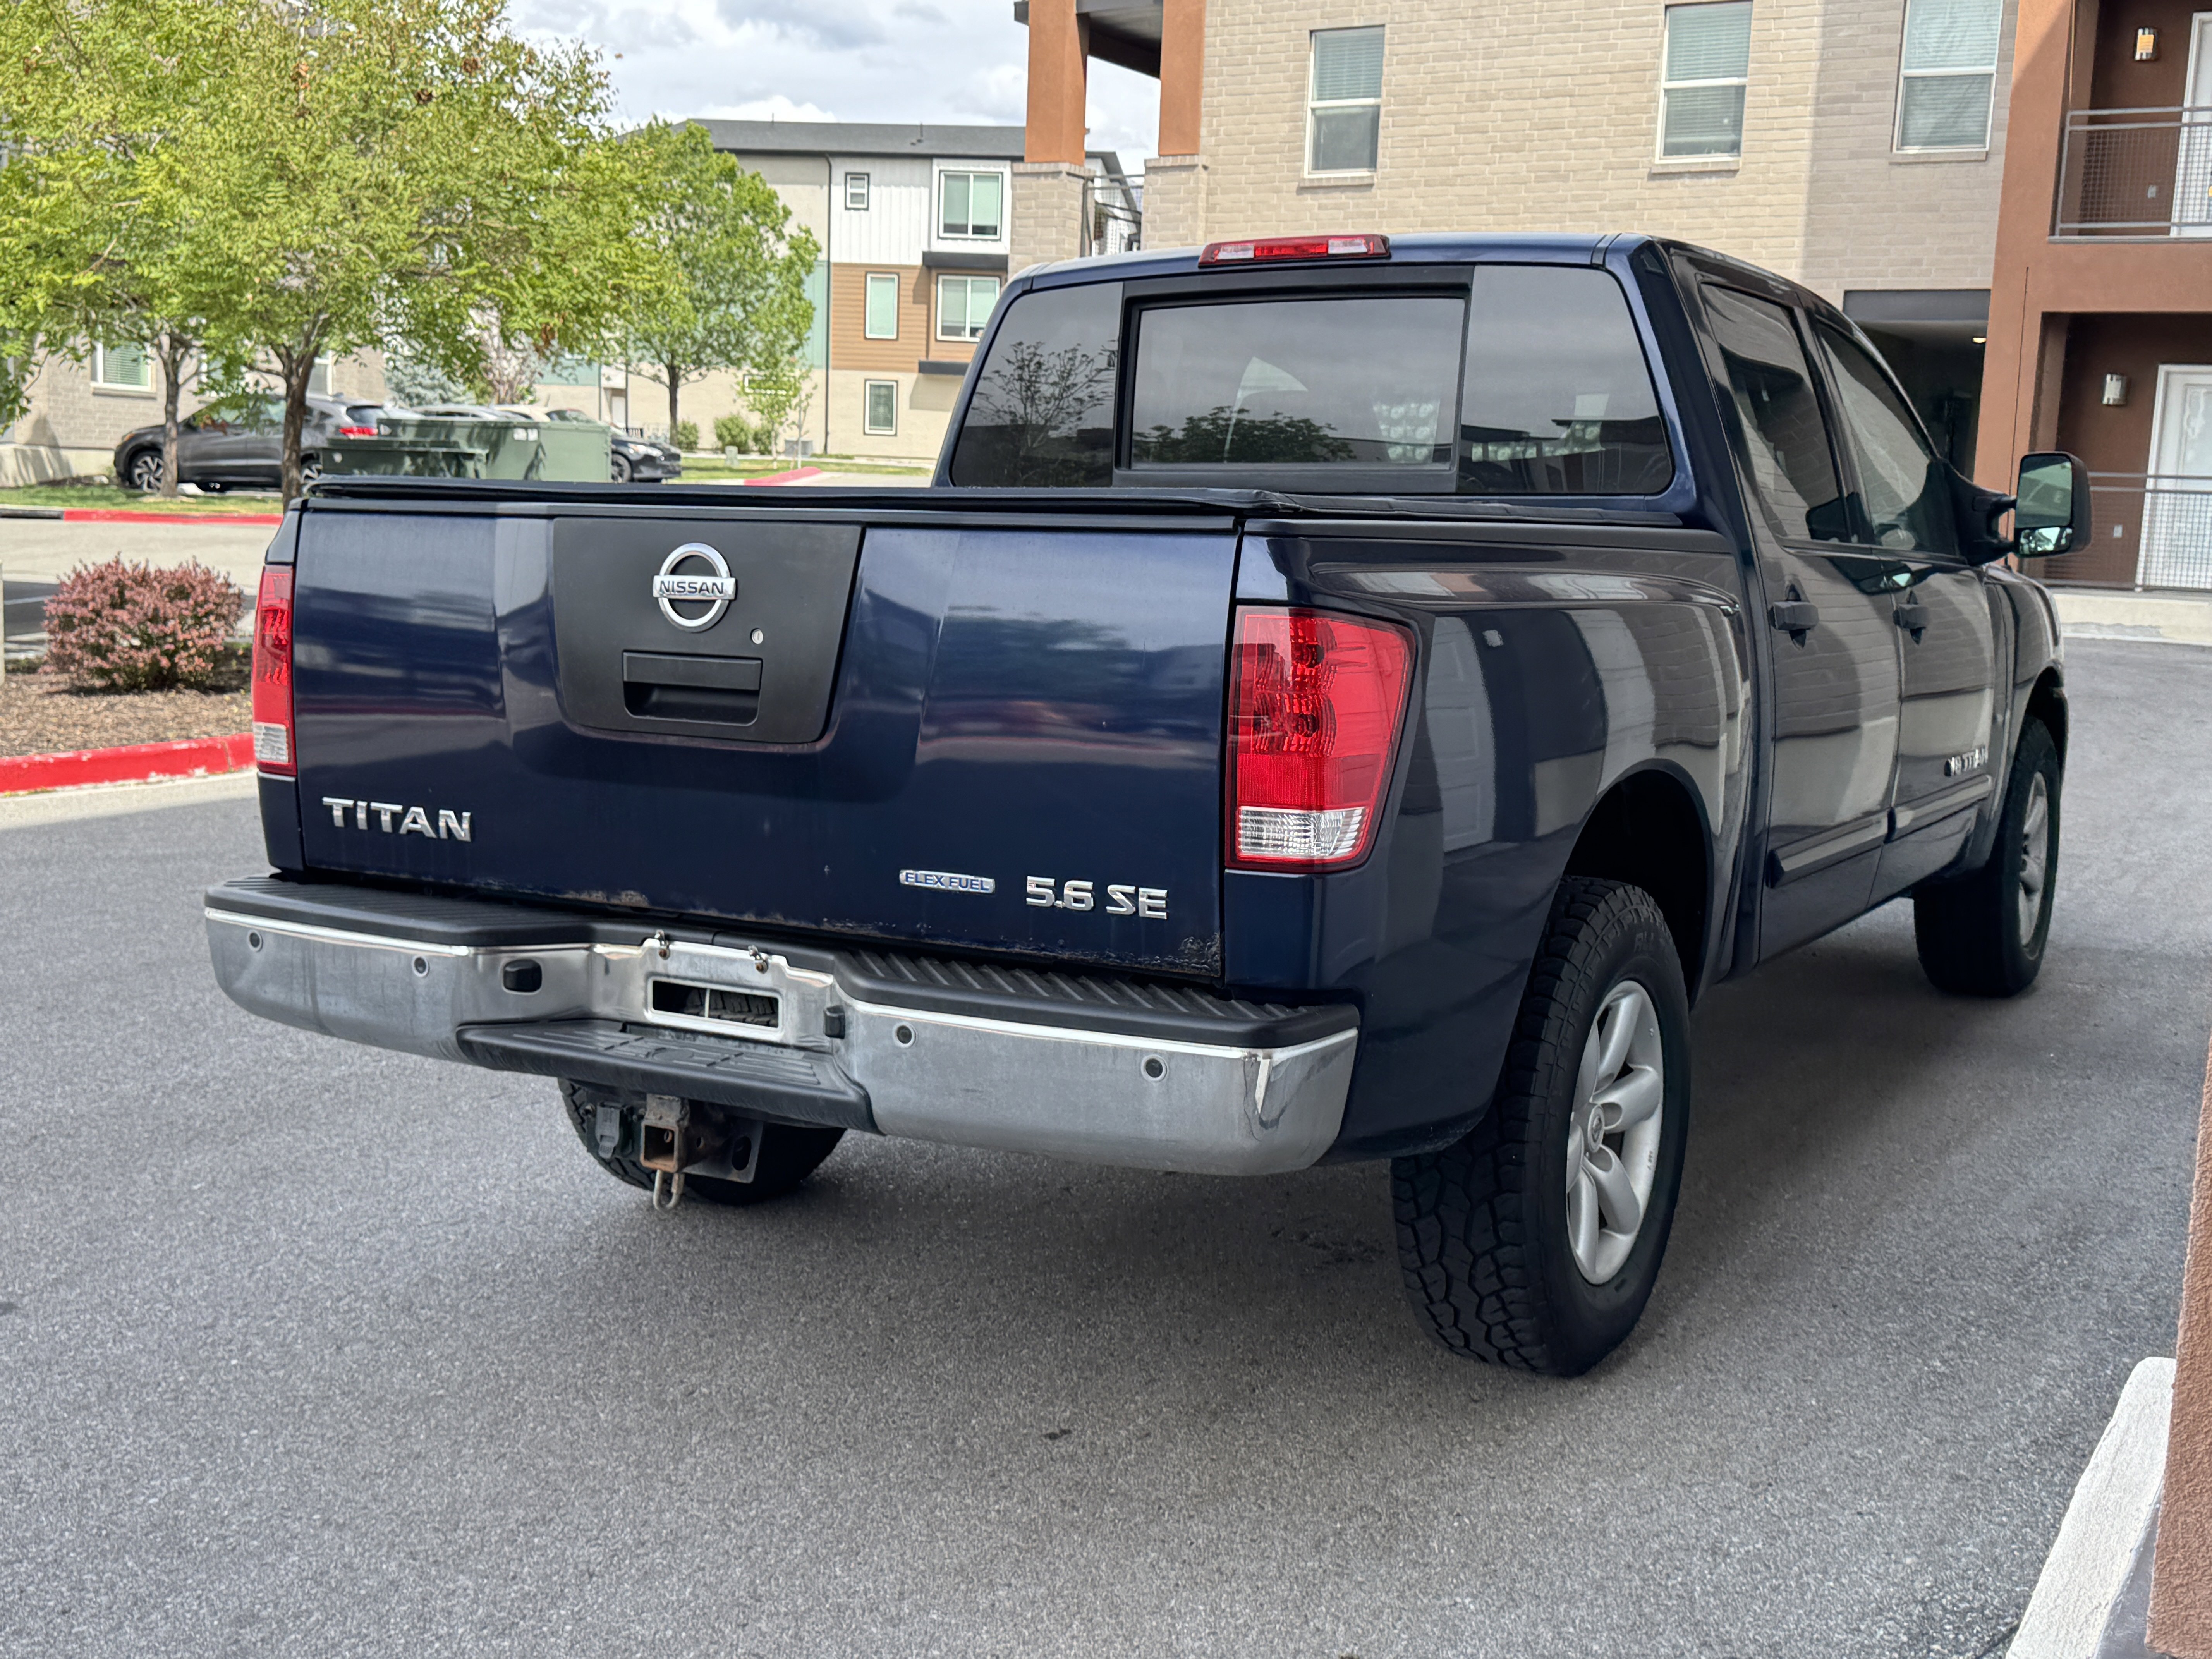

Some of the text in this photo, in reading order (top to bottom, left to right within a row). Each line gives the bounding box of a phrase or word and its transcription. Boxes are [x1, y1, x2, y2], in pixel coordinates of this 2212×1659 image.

[660, 581, 723, 594] NISSAN
[322, 797, 471, 842] TITAN
[905, 872, 990, 891] FLEX FUEL
[1026, 876, 1167, 919] 5.6 SE
